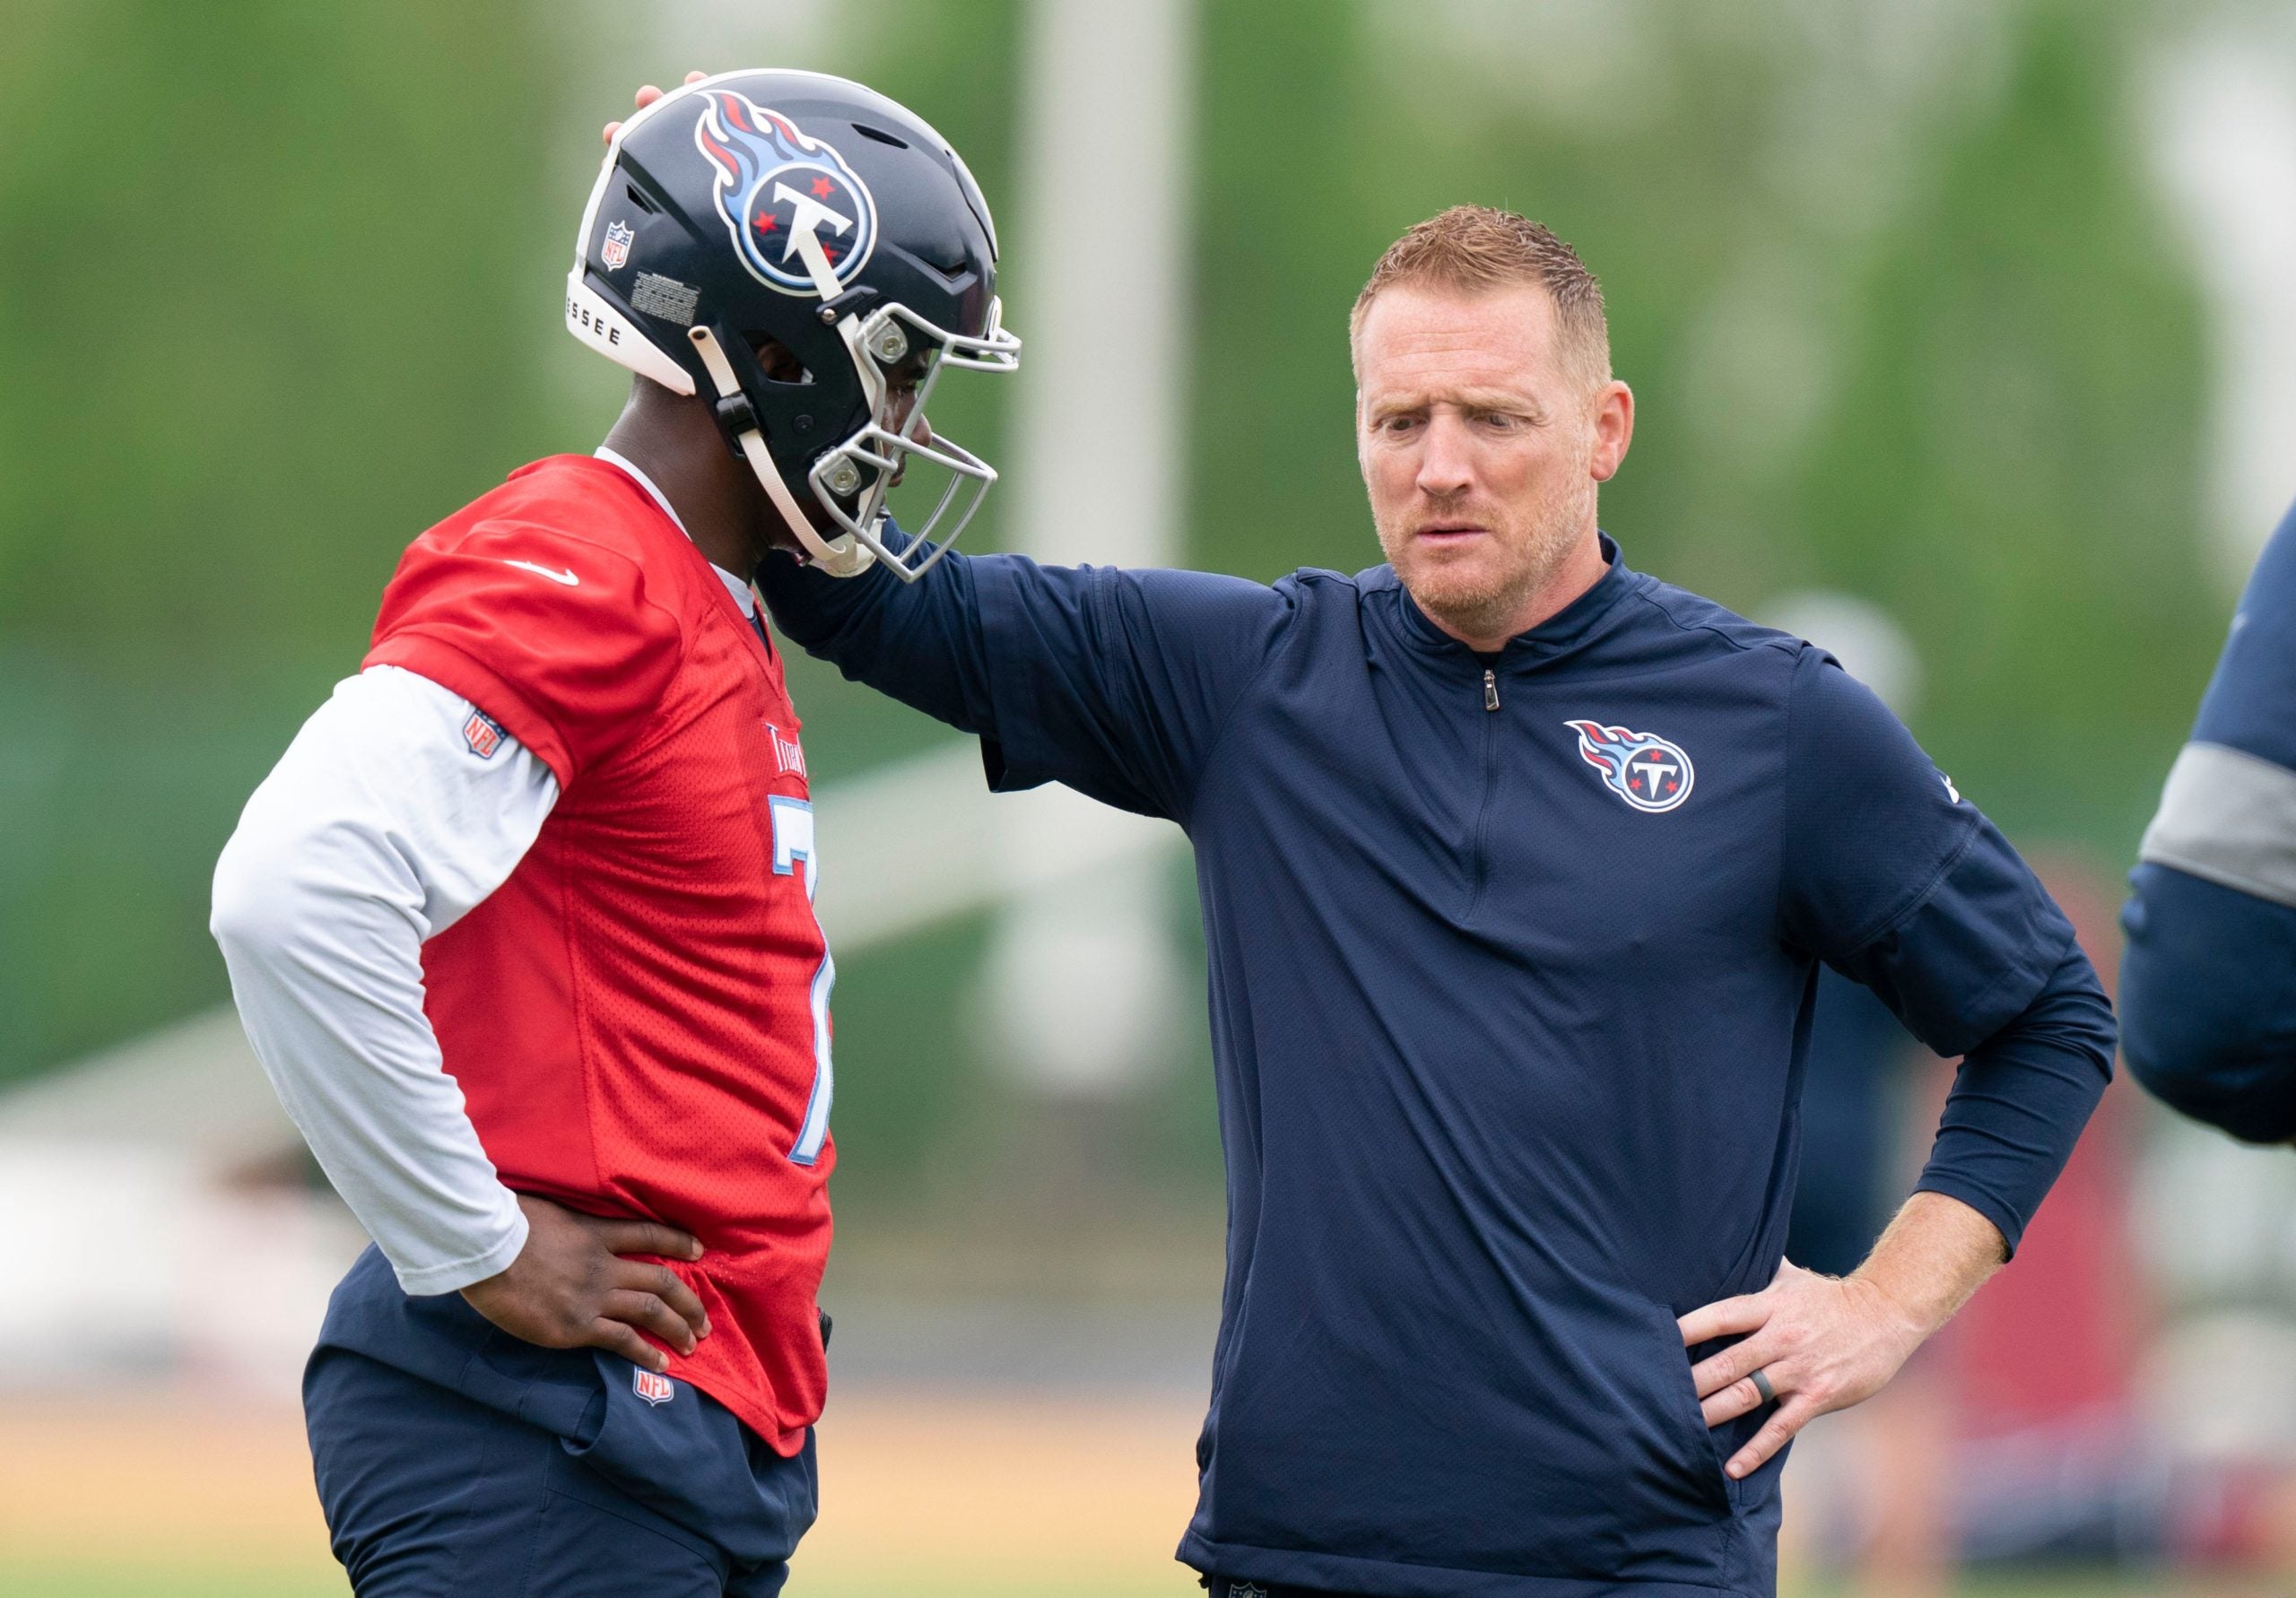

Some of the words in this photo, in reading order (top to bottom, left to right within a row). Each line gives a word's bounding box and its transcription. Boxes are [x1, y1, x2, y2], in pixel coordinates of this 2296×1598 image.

[605, 240, 625, 262] NFL
[465, 716, 497, 756] NFL
[1631, 761, 1678, 800] T
[767, 795, 835, 1166] 7
[638, 1372, 669, 1397] NFL
